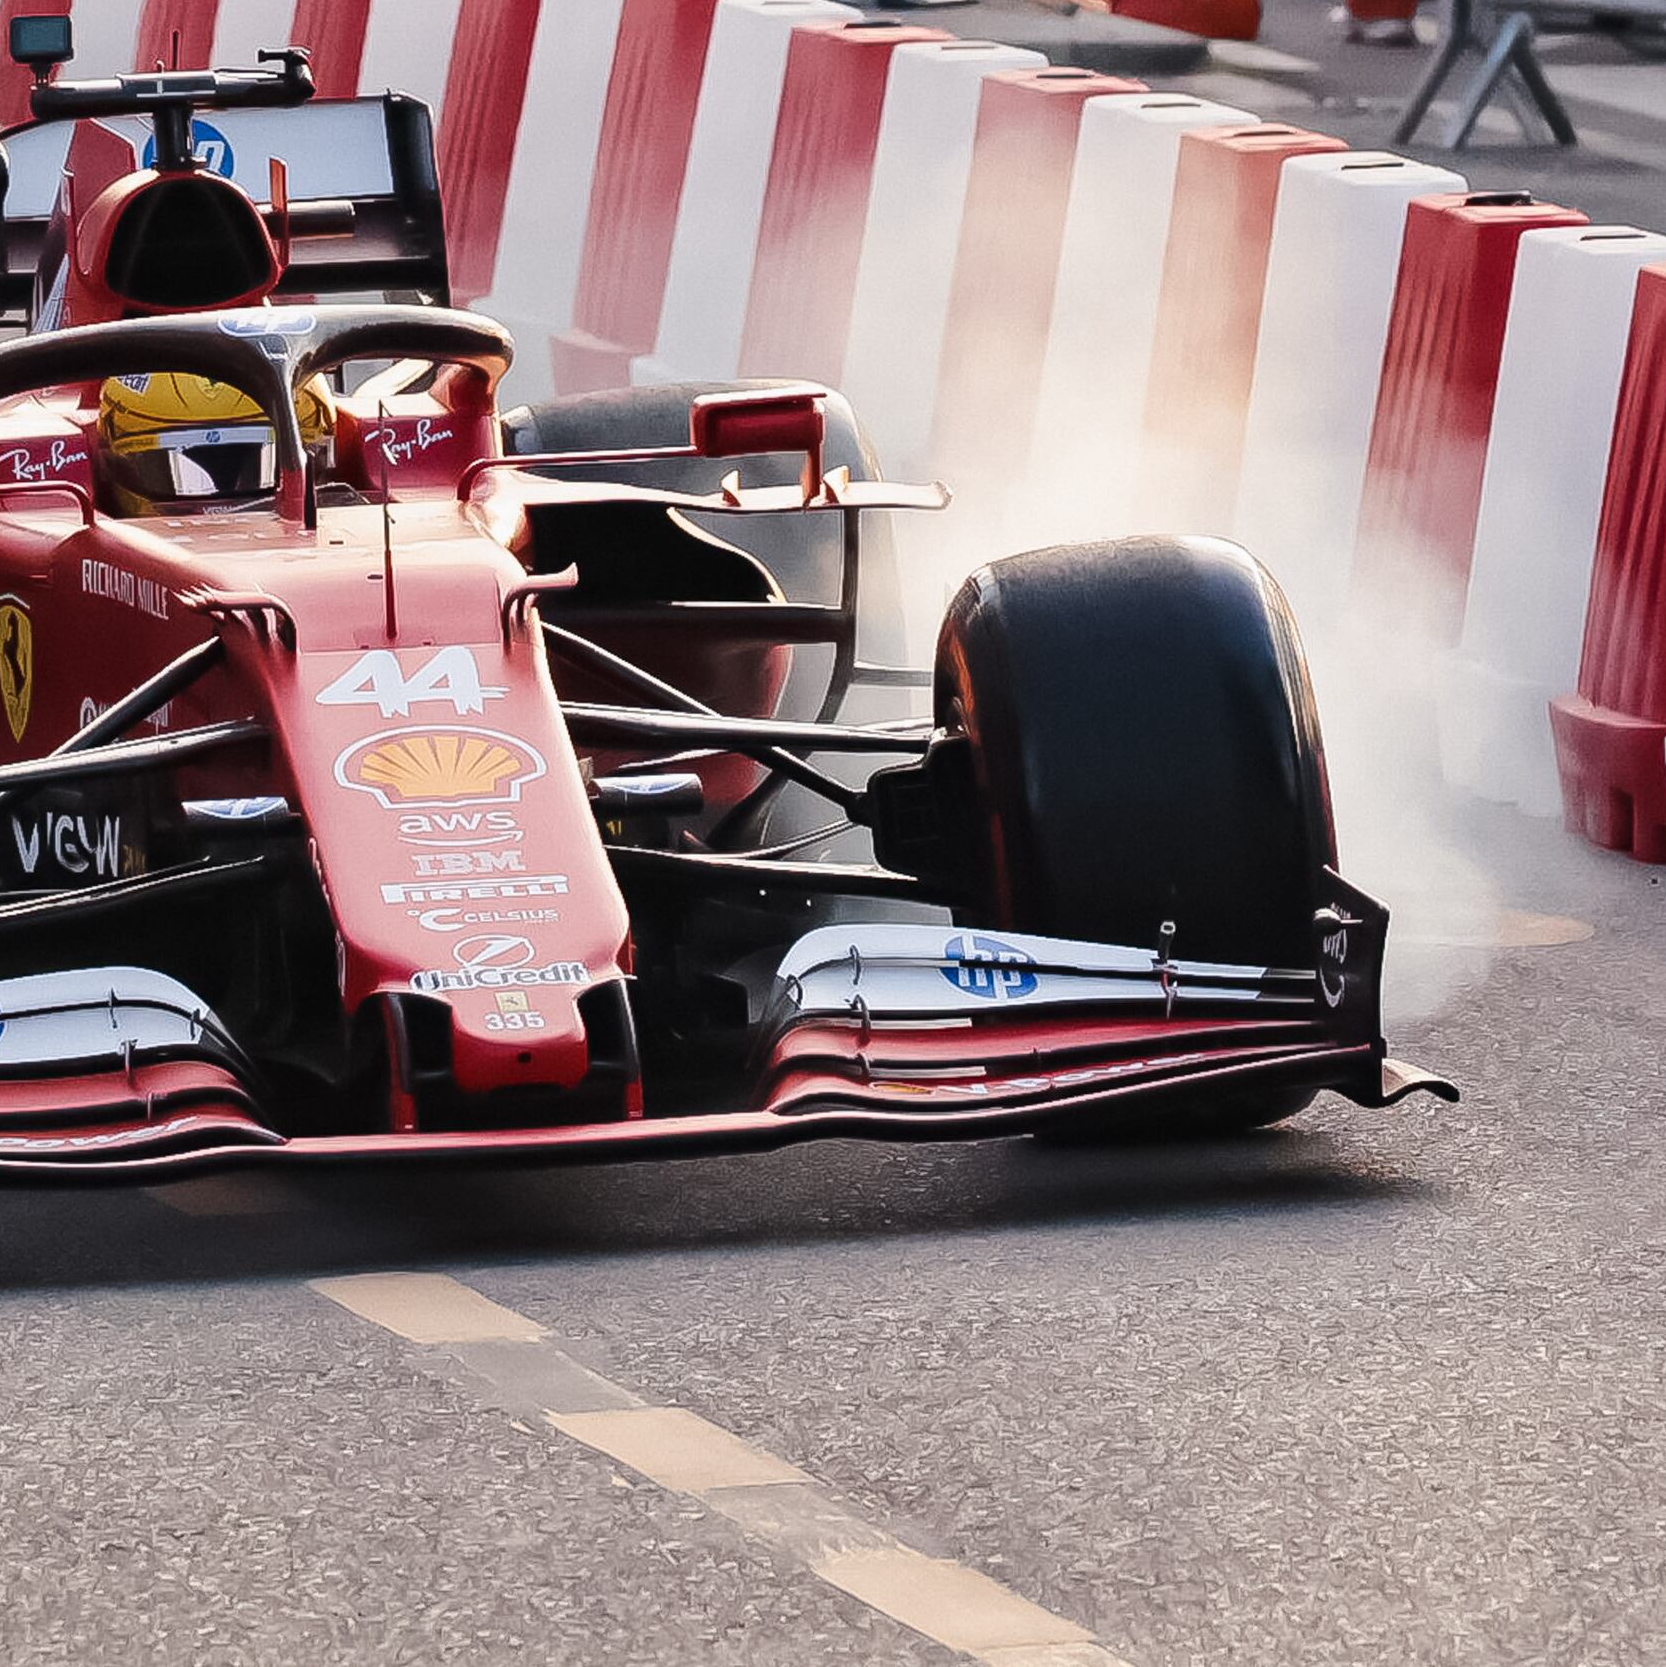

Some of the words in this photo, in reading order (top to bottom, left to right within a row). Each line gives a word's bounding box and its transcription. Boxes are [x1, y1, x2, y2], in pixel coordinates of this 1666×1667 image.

[81, 559, 135, 608] RICHARD
[137, 577, 170, 621] MILLE
[316, 645, 510, 718] 44
[398, 811, 518, 835] aws
[412, 850, 526, 876] IBM
[380, 874, 570, 905] PIRELLI
[464, 909, 559, 923] CELSIUS
[411, 962, 586, 992] UniCredit
[958, 933, 1027, 1000] hp
[484, 1011, 546, 1030] 335
